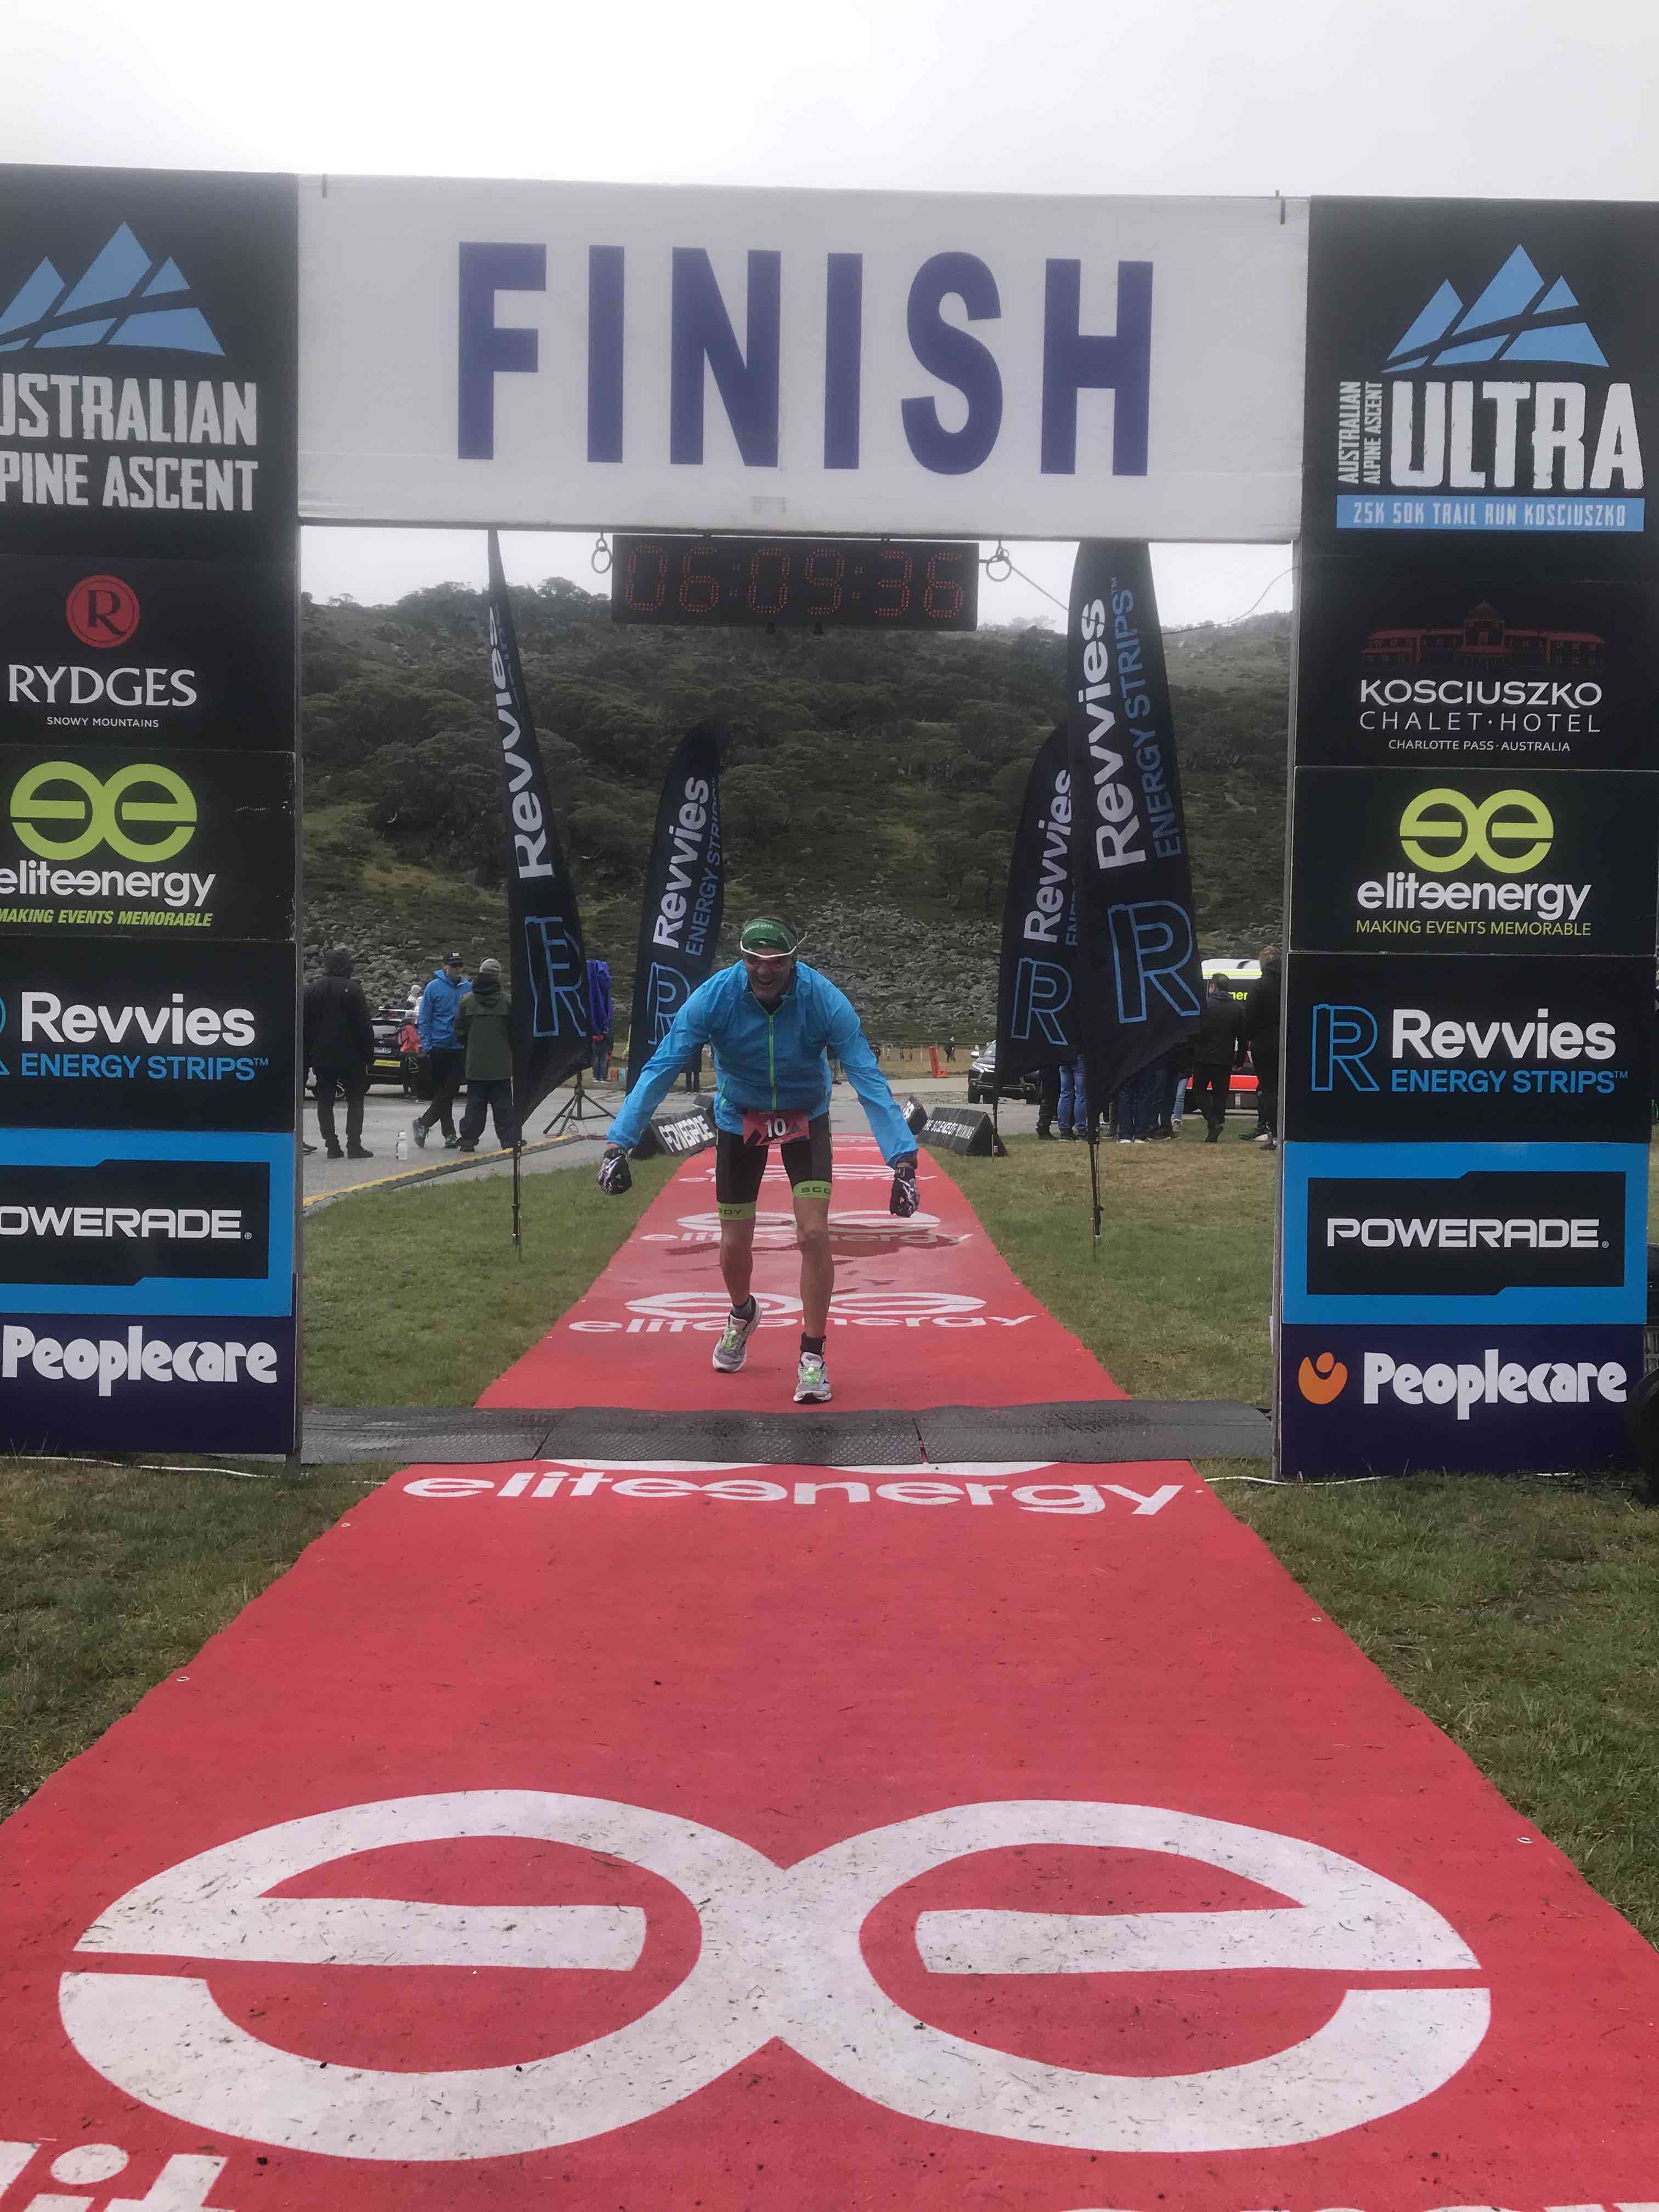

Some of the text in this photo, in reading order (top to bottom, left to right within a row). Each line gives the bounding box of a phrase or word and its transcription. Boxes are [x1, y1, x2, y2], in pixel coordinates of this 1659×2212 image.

[458, 242, 1153, 476] FINISH
[1338, 381, 1361, 484] AUSTRALIAN
[1363, 381, 1383, 484] ALPINE ASCENT
[1391, 381, 1644, 489] ULTRA
[0, 450, 258, 511] PINE ASCENT
[1353, 502, 1626, 527] 25K 50K TRAIL RUN KOSCIUSZKO
[626, 545, 963, 619] 06:09:36
[8, 664, 197, 707] RYDGES
[1361, 679, 1602, 709] KOSCIUSZKO
[47, 716, 159, 728] SNOWY MOUNTAINS
[1079, 598, 1147, 869] Revvies
[1389, 739, 1459, 750] CHARLOTTE
[1130, 727, 1181, 858] ENERGY
[653, 777, 709, 949] Revvies
[58, 910, 115, 924] EVENTS
[117, 911, 212, 926] MEMORABLE
[685, 867, 718, 956] ENERGY
[1357, 872, 1592, 920] eliteenergy
[1356, 920, 1590, 935] MAKING EVENTS MEMORABLE
[21, 991, 255, 1047] Revvies
[1392, 1008, 1616, 1060] Revvies
[21, 1053, 141, 1079] ENERGY
[1391, 1069, 1507, 1093] ENERGY
[764, 1118, 786, 1137] 10
[2, 1325, 278, 1397] Peoplecare
[1363, 1348, 1627, 1420] Peoplecare
[403, 1471, 1184, 1515] eliteenergy
